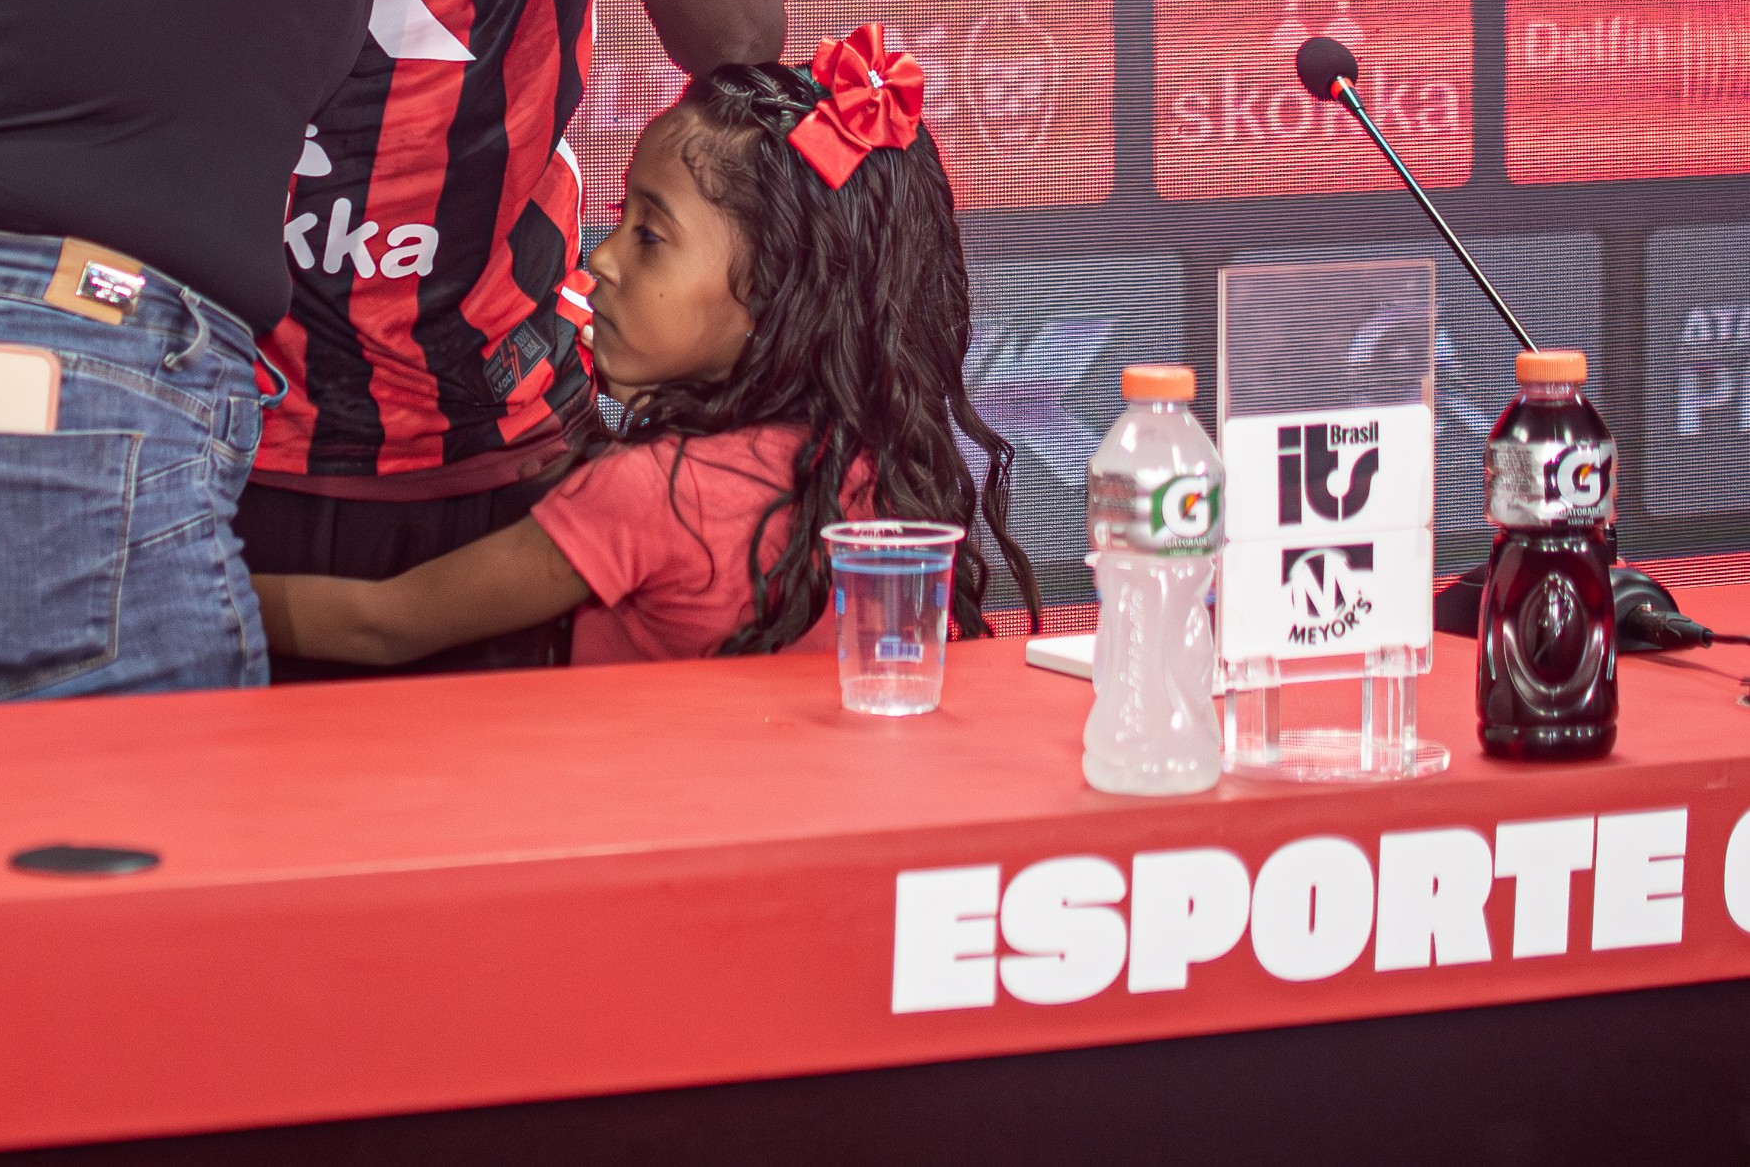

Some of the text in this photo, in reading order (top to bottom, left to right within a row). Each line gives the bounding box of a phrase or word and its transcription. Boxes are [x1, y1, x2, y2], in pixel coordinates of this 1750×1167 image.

[1523, 14, 1668, 69] Delfin
[1329, 420, 1379, 445] Brasil
[1162, 476, 1211, 538] G
[1288, 590, 1373, 645] MEYOR'S
[892, 808, 1688, 1015] ESPORTE
